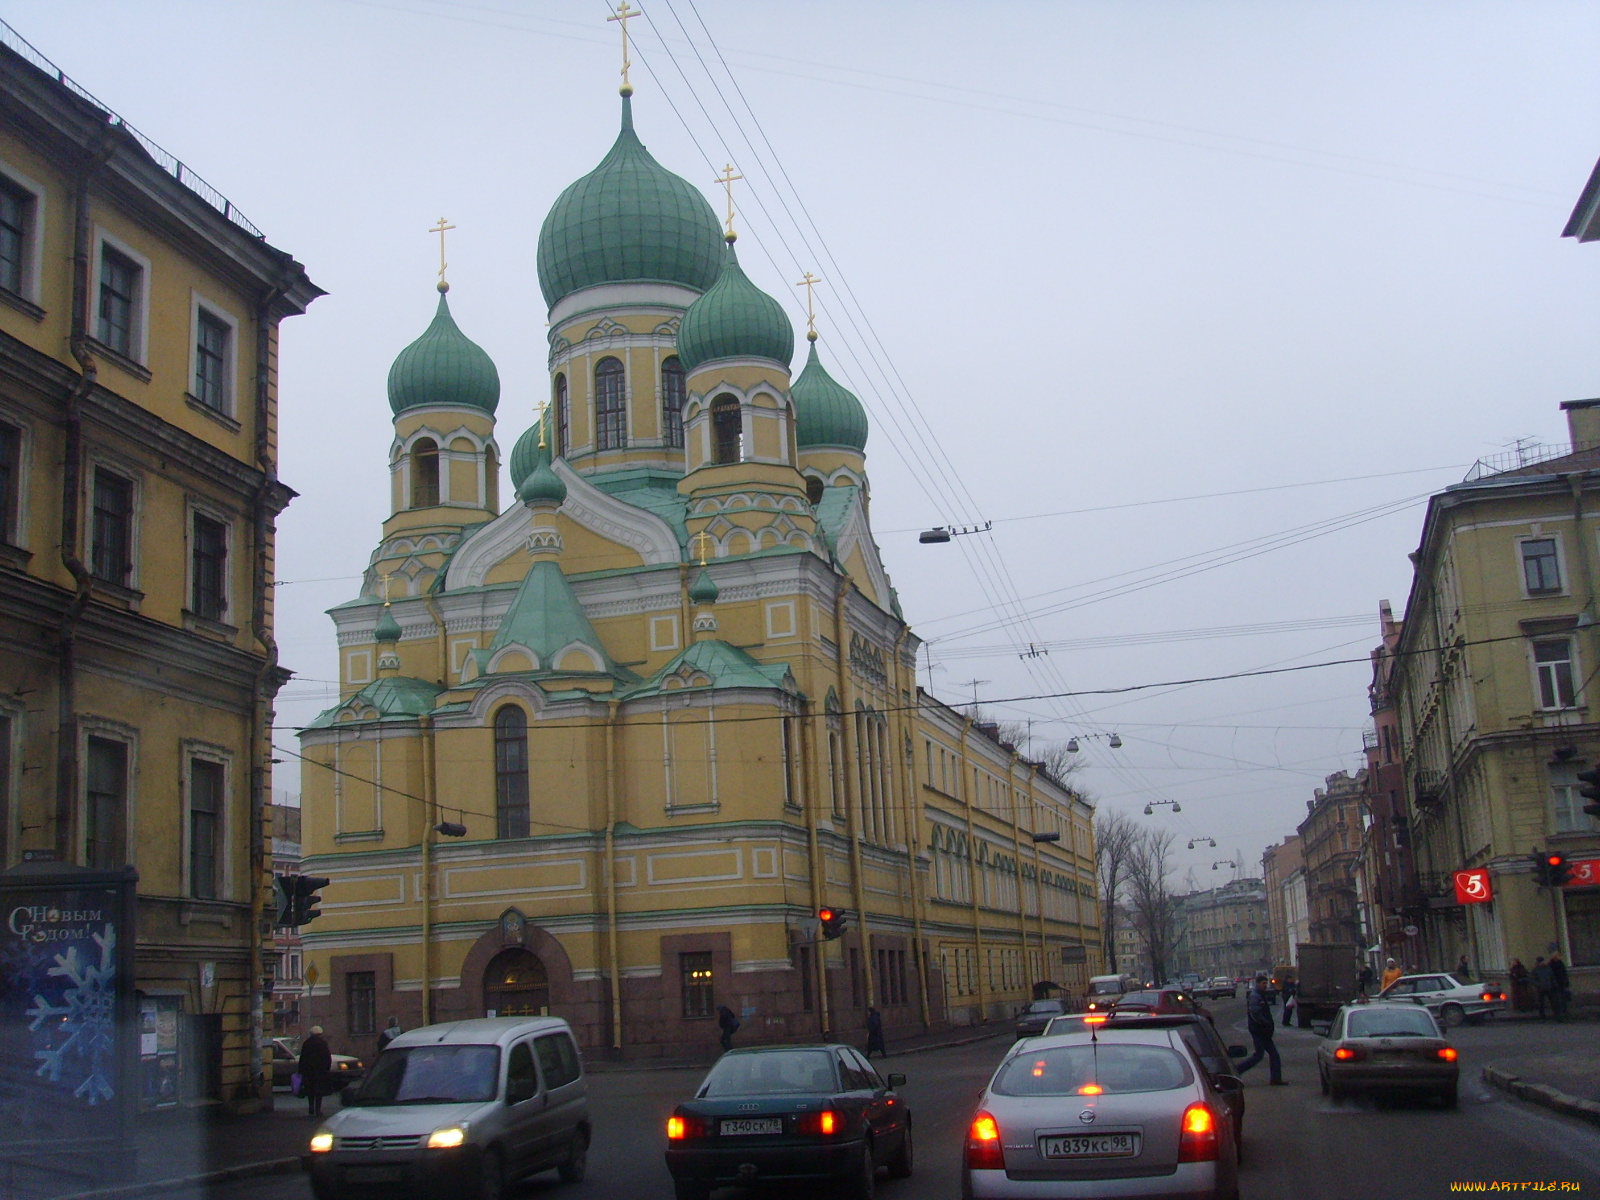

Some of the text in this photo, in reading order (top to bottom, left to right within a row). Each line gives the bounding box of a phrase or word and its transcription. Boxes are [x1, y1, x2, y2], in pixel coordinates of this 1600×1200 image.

[1579, 864, 1592, 879] 5
[1466, 875, 1482, 894] 5
[1113, 1136, 1128, 1148] 98
